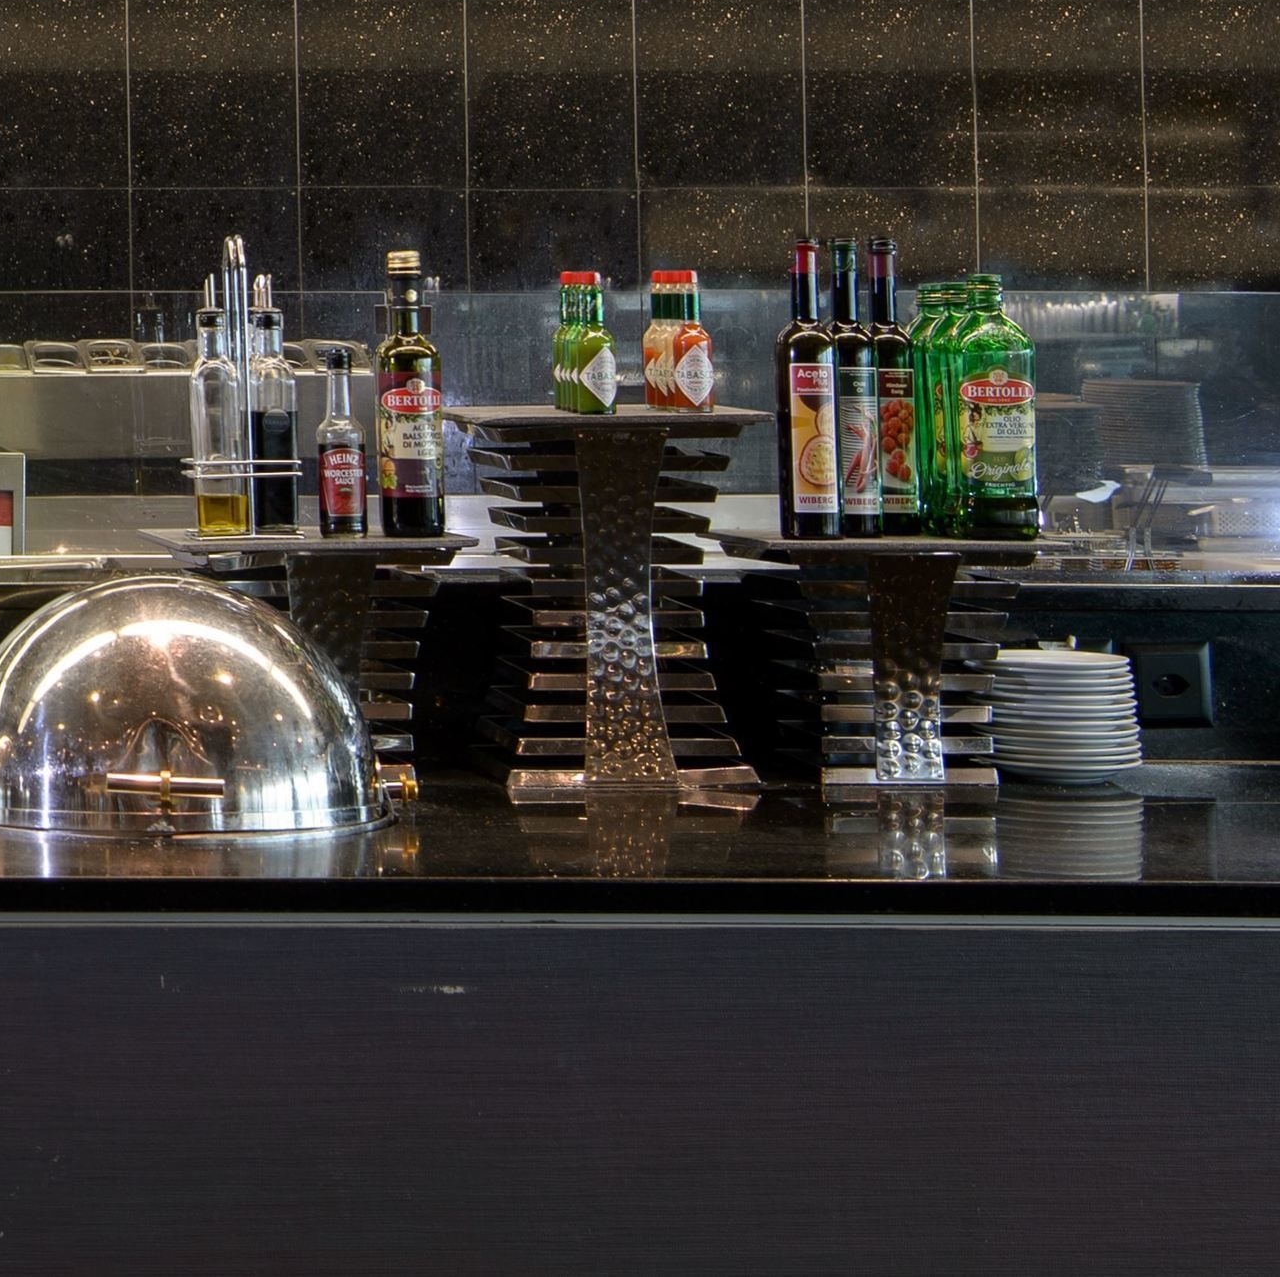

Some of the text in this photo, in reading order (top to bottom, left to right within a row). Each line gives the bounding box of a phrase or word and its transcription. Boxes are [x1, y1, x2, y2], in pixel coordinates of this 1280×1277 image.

[966, 385, 1032, 398] BERTOLLI
[329, 453, 359, 466] HEINZ
[798, 496, 834, 505] WIBERG
